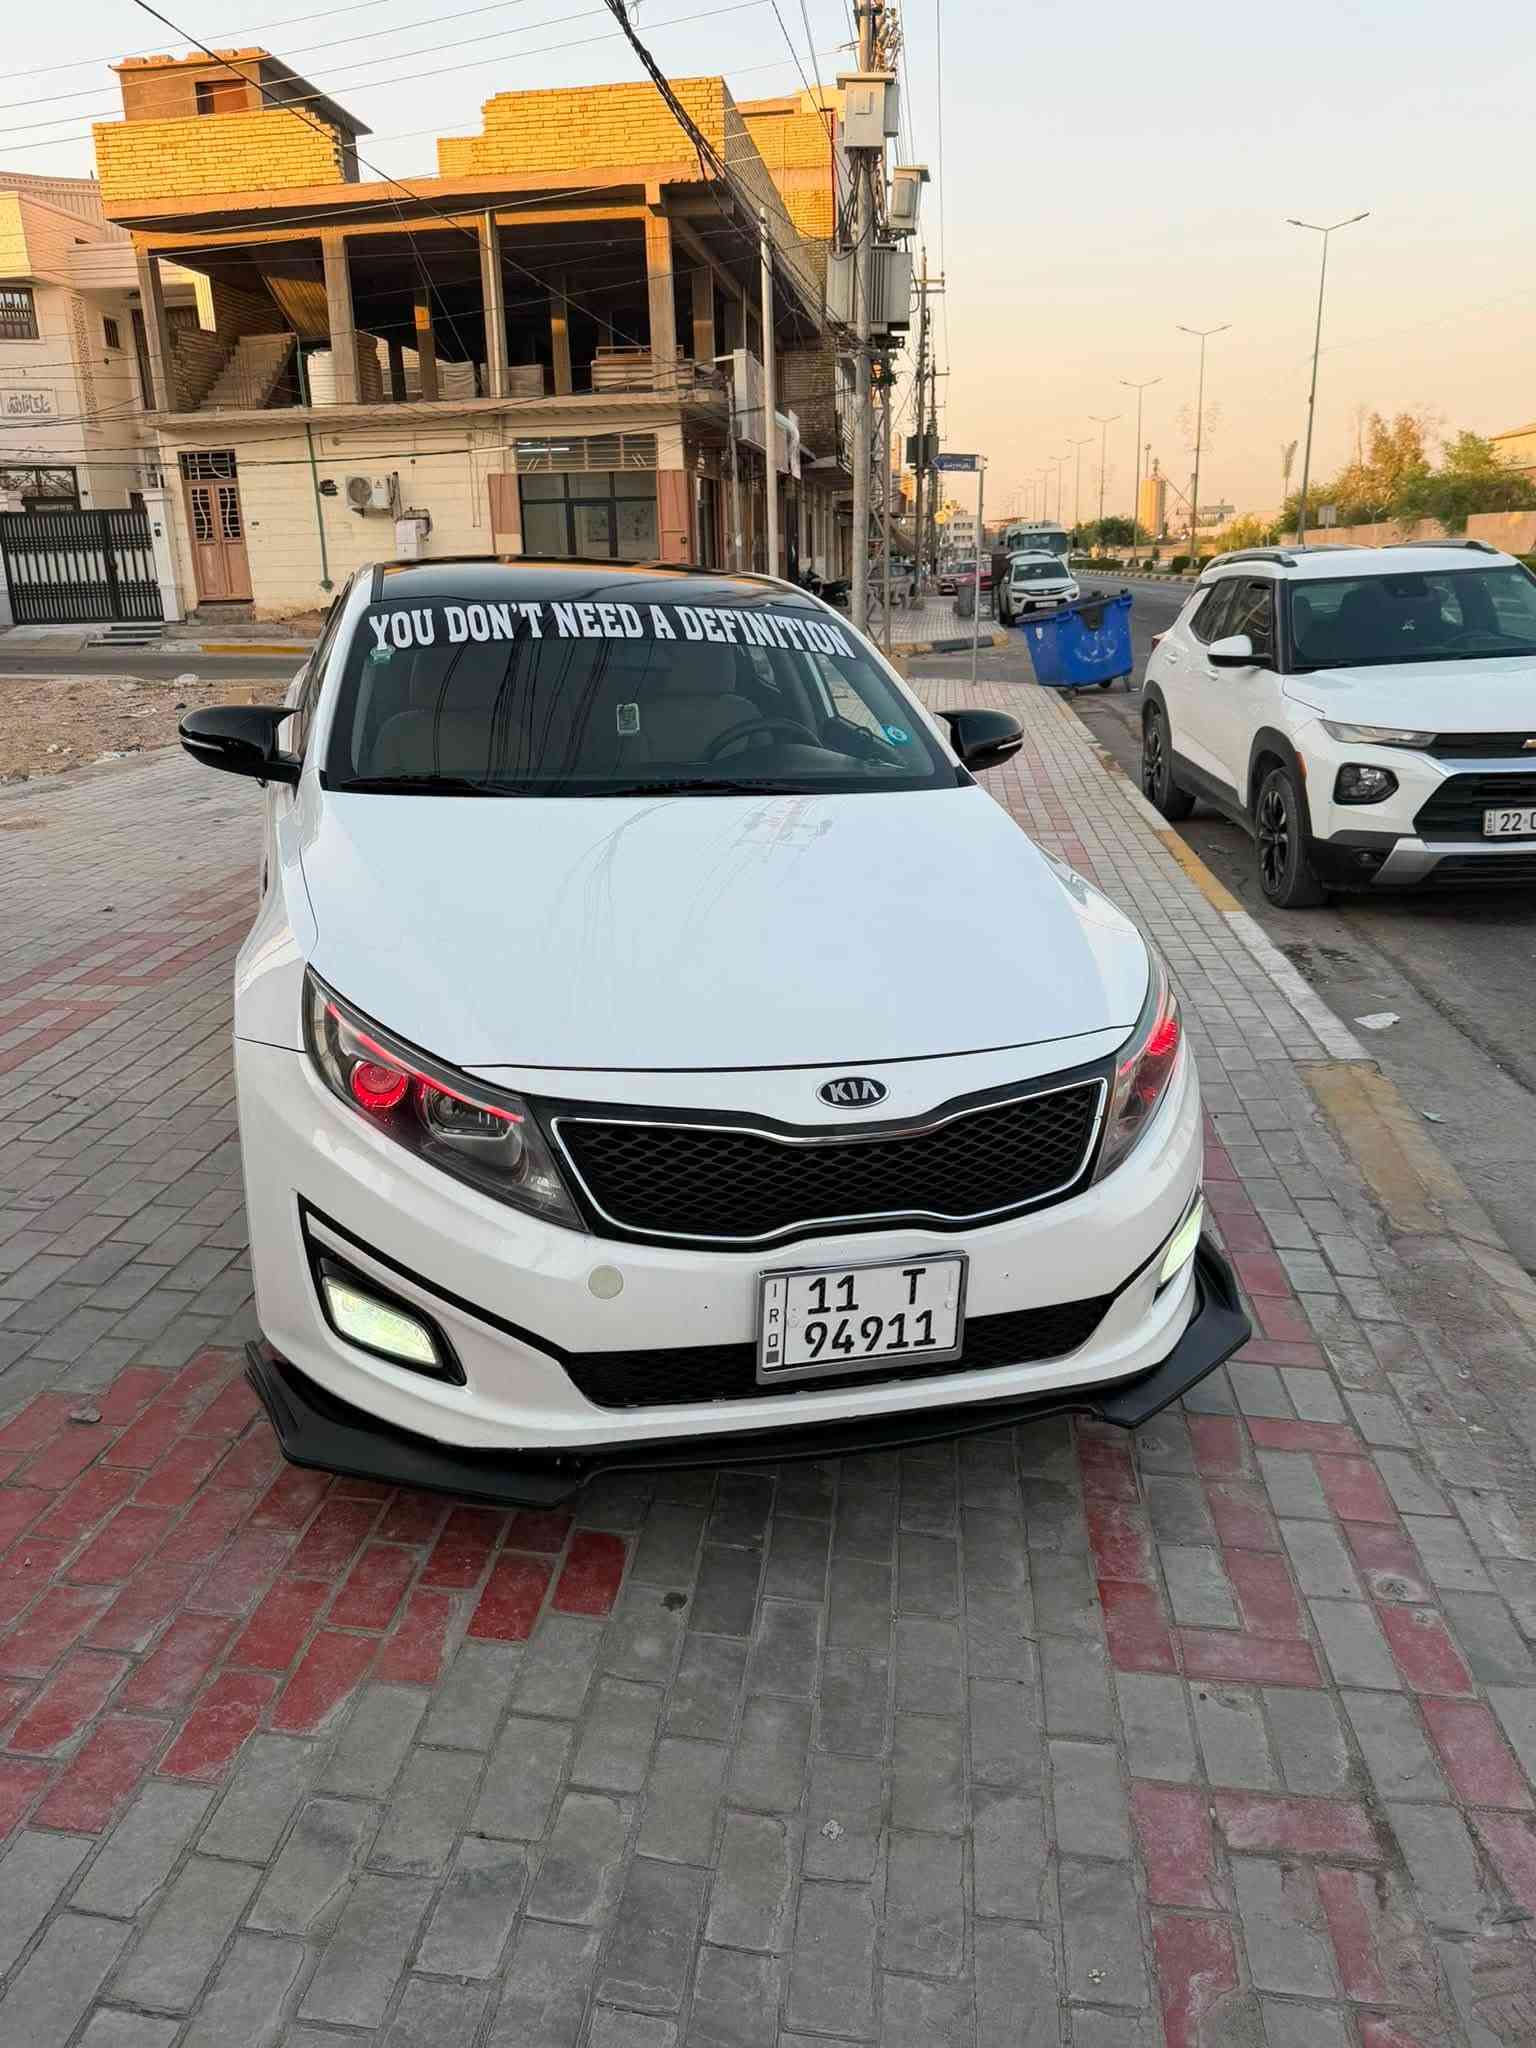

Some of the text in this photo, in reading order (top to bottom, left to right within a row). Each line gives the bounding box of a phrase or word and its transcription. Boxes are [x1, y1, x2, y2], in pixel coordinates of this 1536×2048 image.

[369, 602, 857, 659] YOU DON'T NEED A DEFINITION
[1500, 812, 1523, 832] 22
[828, 1080, 880, 1102] KIA
[807, 1267, 926, 1315] 11 T
[804, 1309, 937, 1358] 94911
